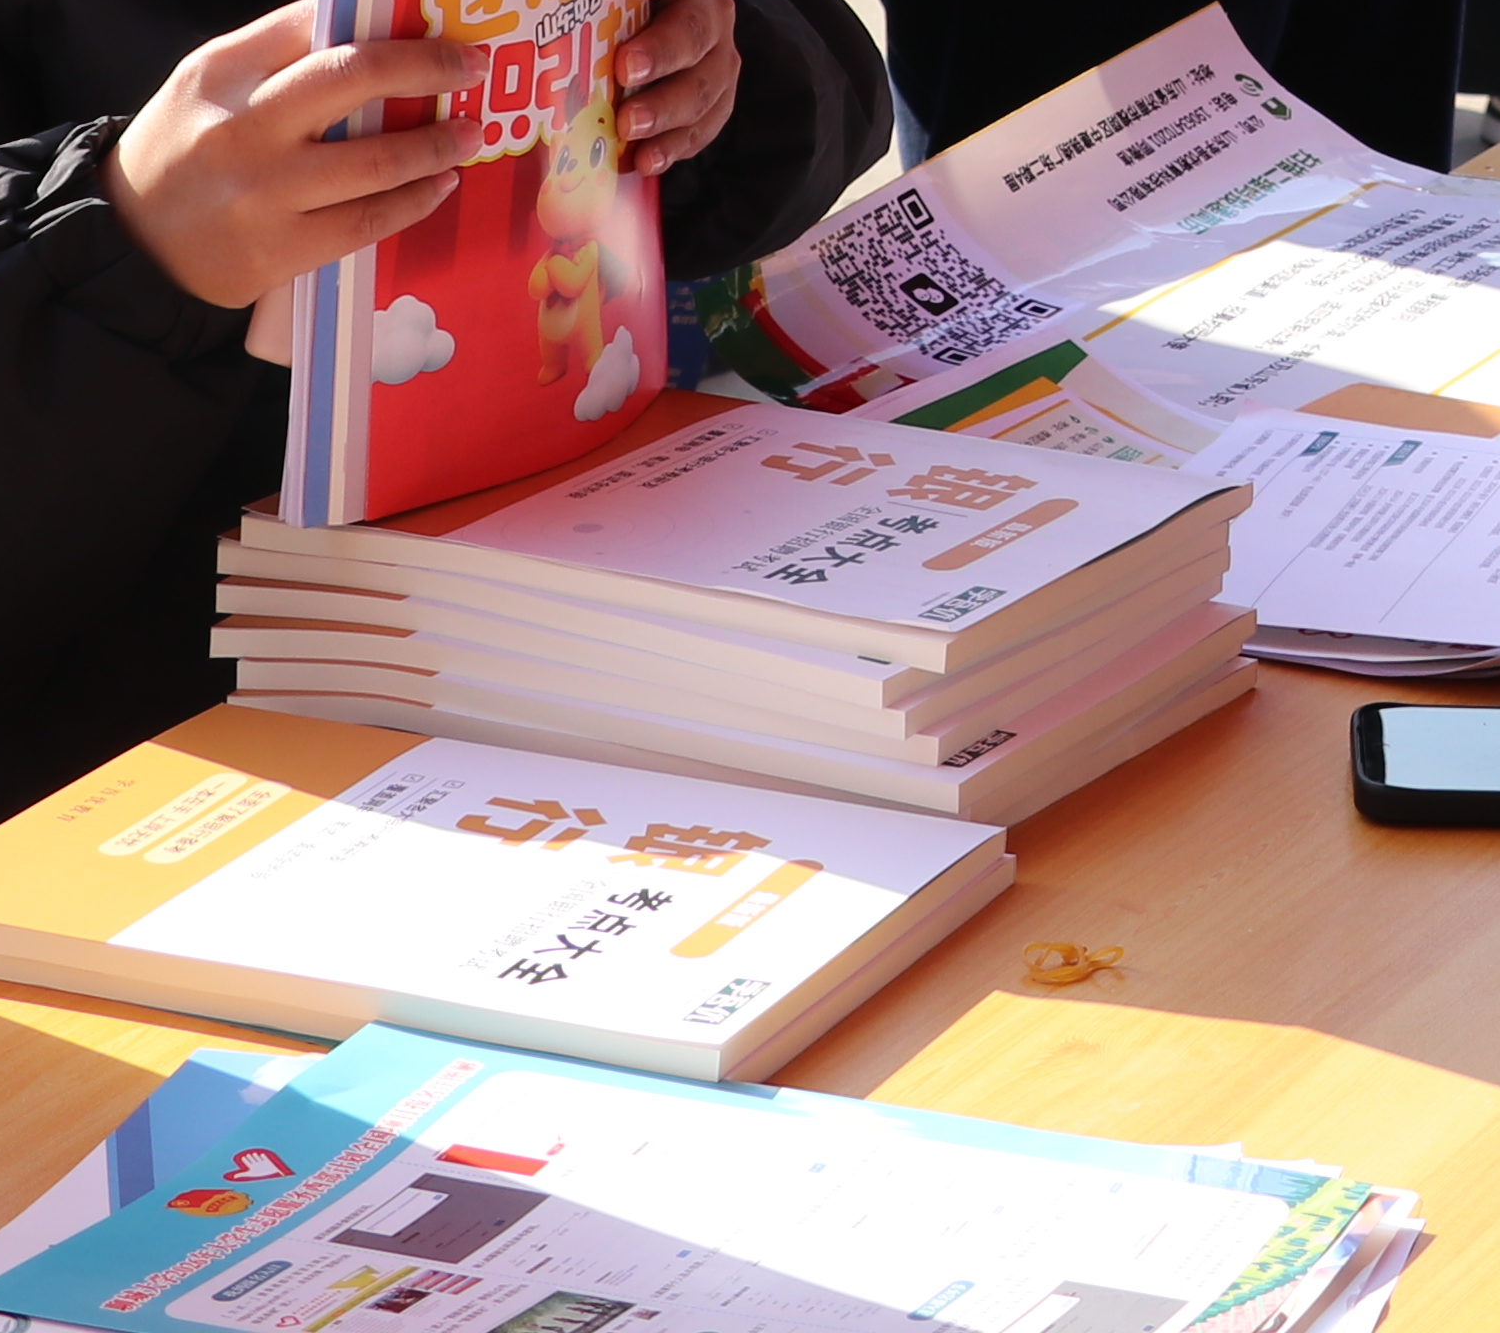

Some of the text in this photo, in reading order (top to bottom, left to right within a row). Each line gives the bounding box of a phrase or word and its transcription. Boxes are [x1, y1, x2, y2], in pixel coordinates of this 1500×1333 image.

[760, 441, 1039, 513] 银行
[762, 514, 941, 586] 考点大全
[454, 794, 772, 878] 银行
[496, 882, 674, 987] 考点大全
